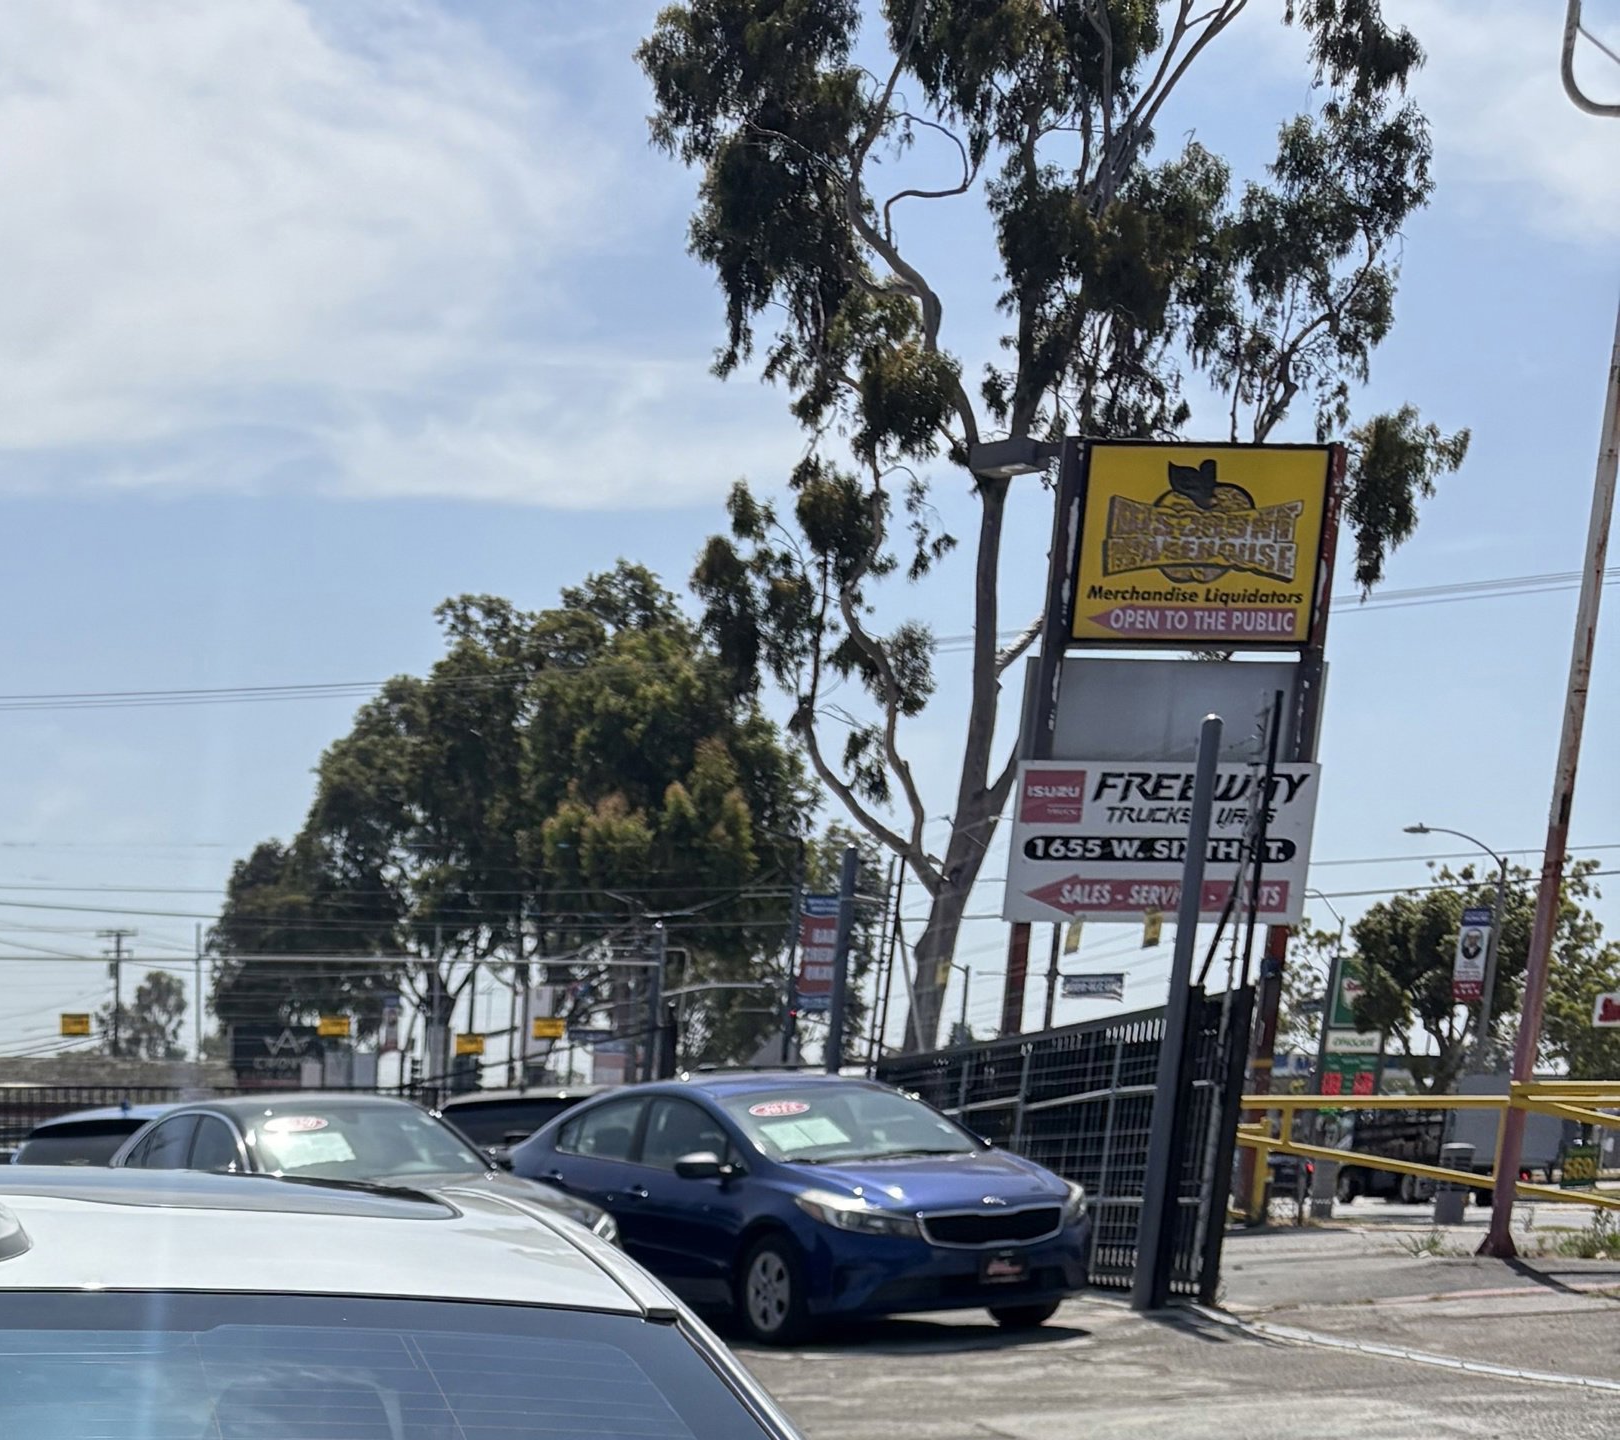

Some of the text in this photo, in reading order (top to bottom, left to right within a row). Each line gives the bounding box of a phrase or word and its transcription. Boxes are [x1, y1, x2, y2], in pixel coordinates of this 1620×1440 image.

[1087, 585, 1304, 607] Merchandise Liquidators
[1110, 608, 1295, 633] OPEN TO THE PUBLIC
[1026, 784, 1081, 798] ISUZU
[1033, 838, 1102, 858] 1655
[1109, 840, 1144, 859] W.
[1152, 841, 1239, 861] SITH
[1059, 880, 1112, 906] SALES
